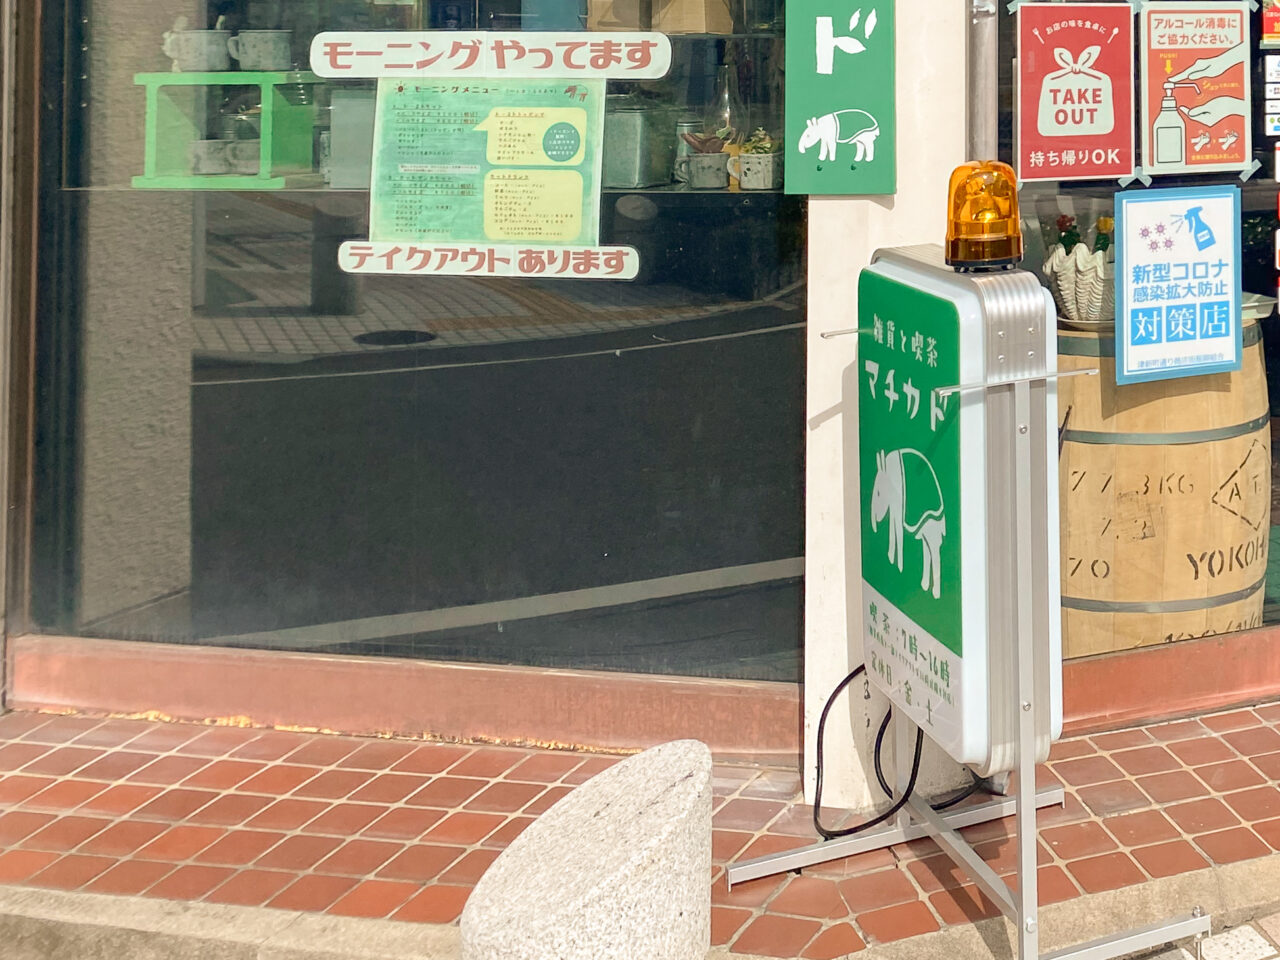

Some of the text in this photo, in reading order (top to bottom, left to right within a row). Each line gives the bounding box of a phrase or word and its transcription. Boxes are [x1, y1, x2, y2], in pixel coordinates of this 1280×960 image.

[1153, 17, 1237, 30] アルコール消毒に
[1157, 32, 1234, 45] ご協力ください。
[1049, 88, 1103, 105] TAKE
[1054, 108, 1098, 125] OUT
[1030, 149, 1121, 167] 持ち帰りOK
[1132, 259, 1229, 285] 新型コロナ
[1133, 279, 1229, 303] 感染拡大防止
[1133, 305, 1229, 341] 対策店
[873, 312, 938, 368] 雑貨と喫茶
